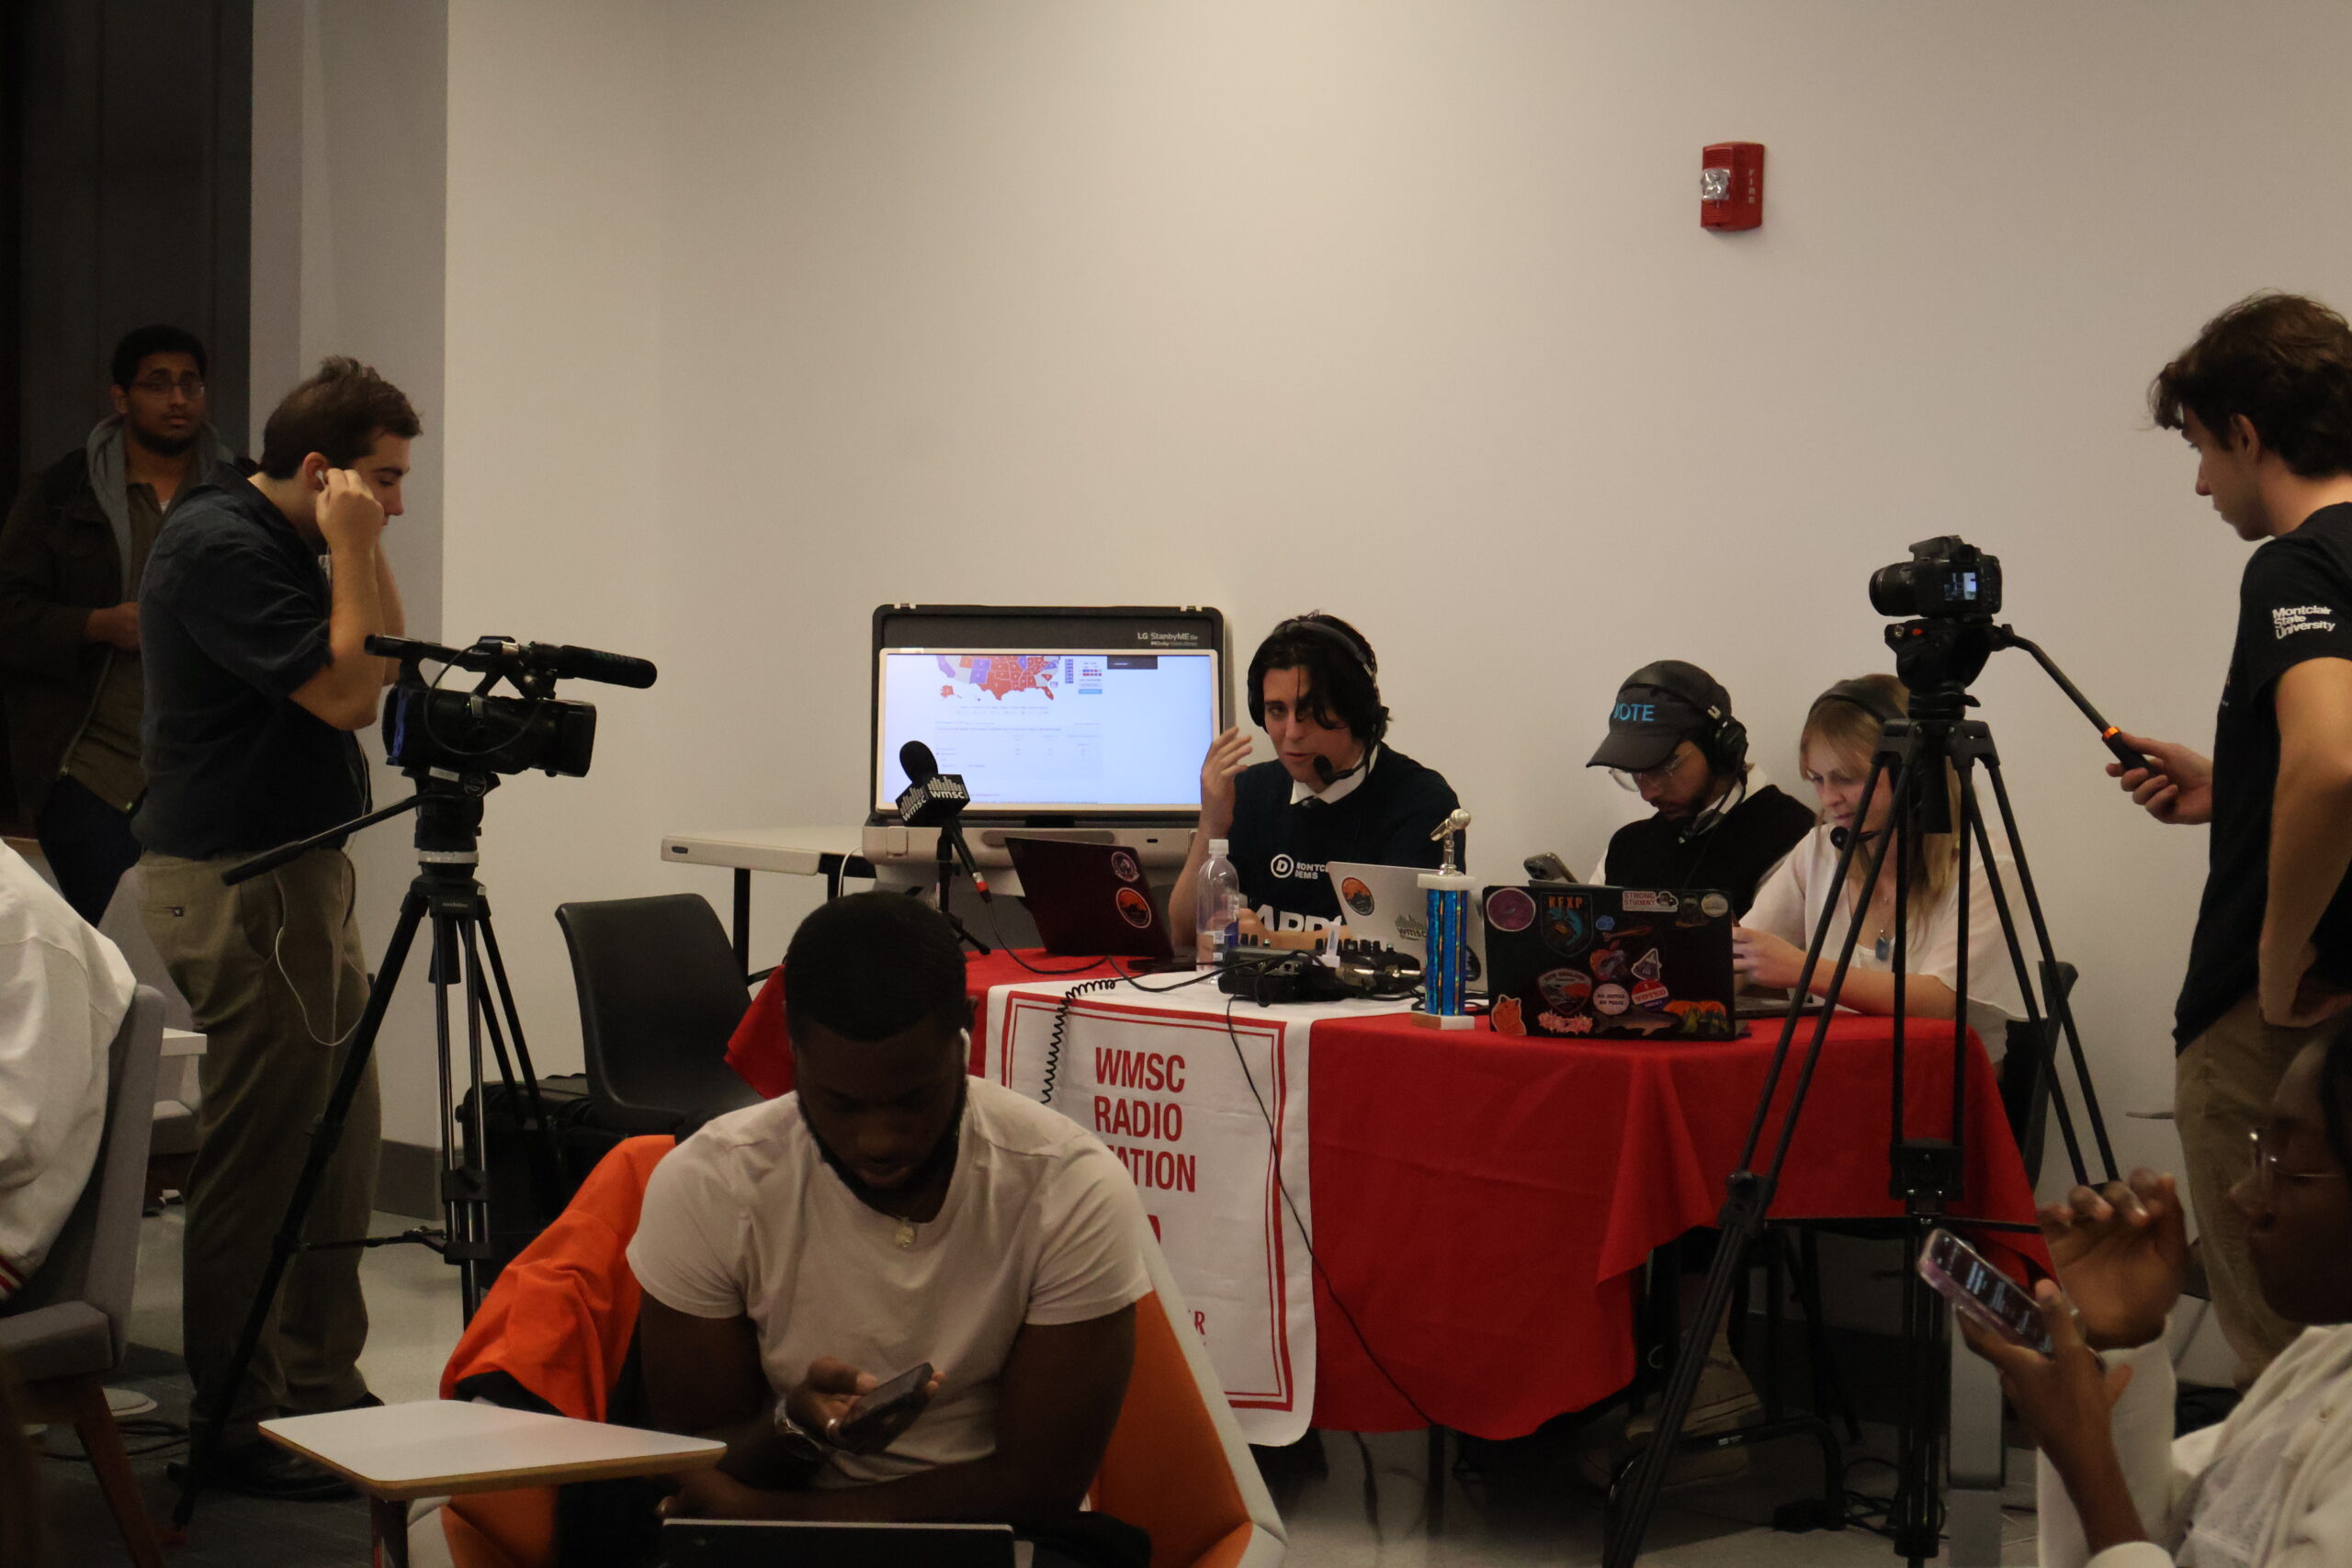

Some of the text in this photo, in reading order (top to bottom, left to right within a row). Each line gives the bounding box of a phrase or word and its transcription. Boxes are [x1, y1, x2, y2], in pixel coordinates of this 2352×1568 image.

[2272, 605, 2333, 619] Montclair
[2273, 615, 2307, 628] State
[2276, 620, 2335, 640] University
[930, 791, 965, 799] wmsc
[902, 795, 927, 822] wmsc
[1634, 989, 1666, 1001] VOTED
[1095, 1047, 1185, 1093] WMSC
[1094, 1095, 1182, 1142] RADIO
